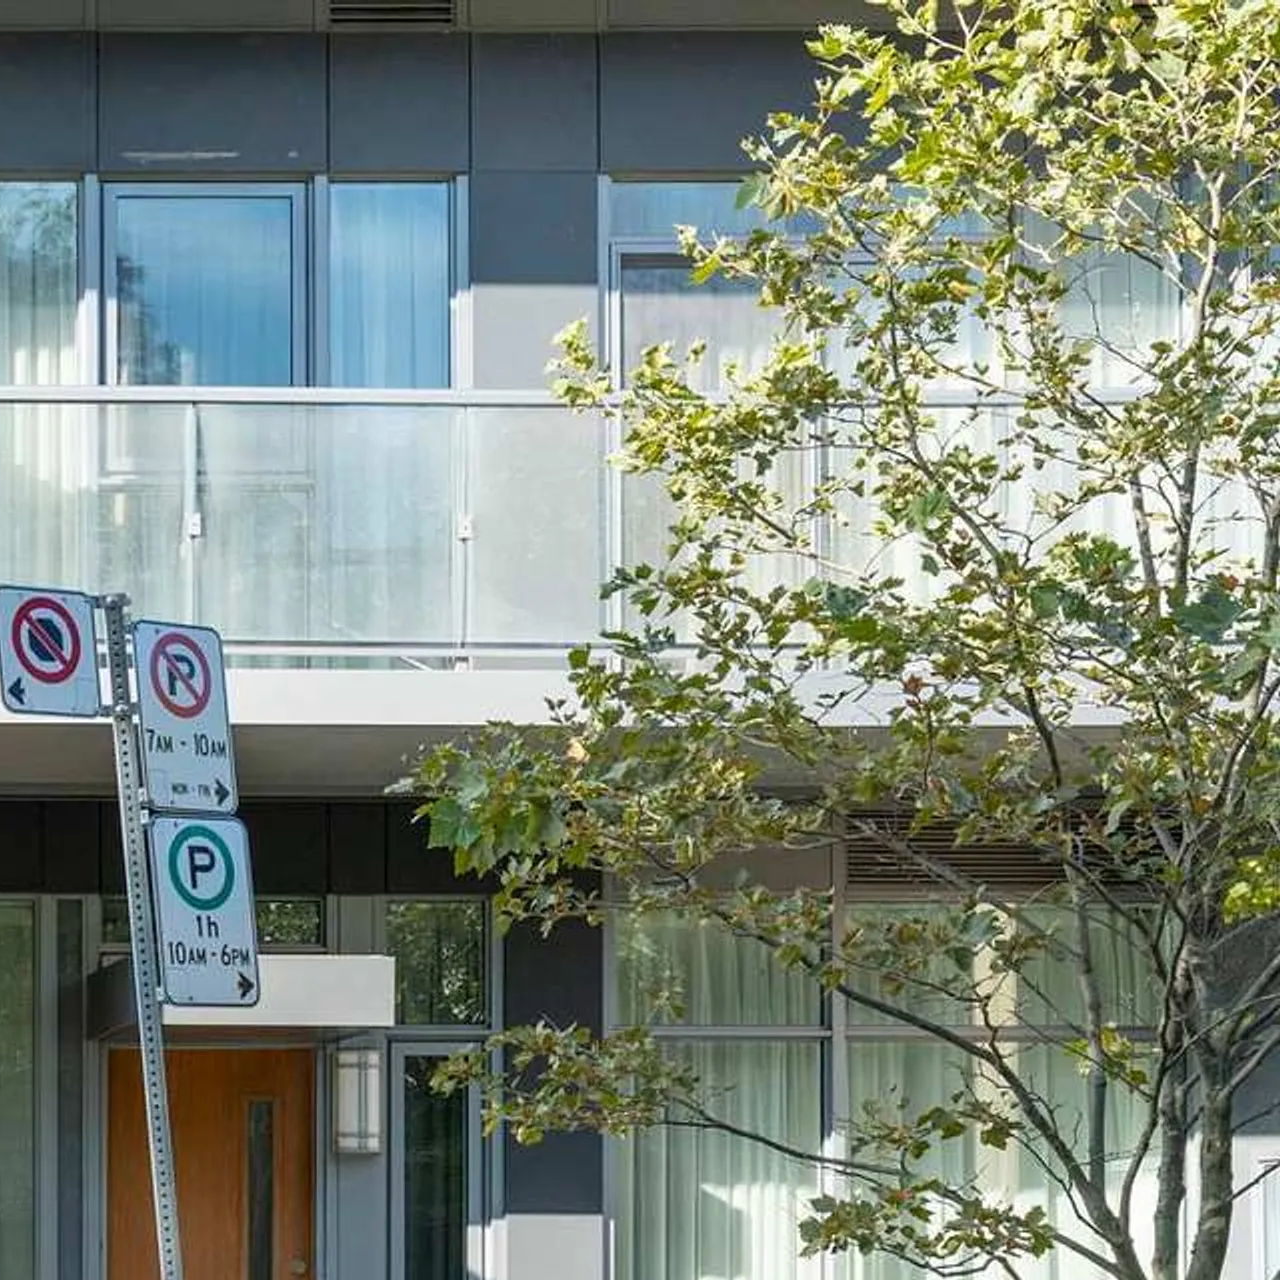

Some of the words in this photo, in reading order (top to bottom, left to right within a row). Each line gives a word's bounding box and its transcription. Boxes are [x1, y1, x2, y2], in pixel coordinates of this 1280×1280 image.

[145, 728, 174, 753] 7AM
[193, 731, 227, 758] 10AM
[188, 846, 216, 889] P
